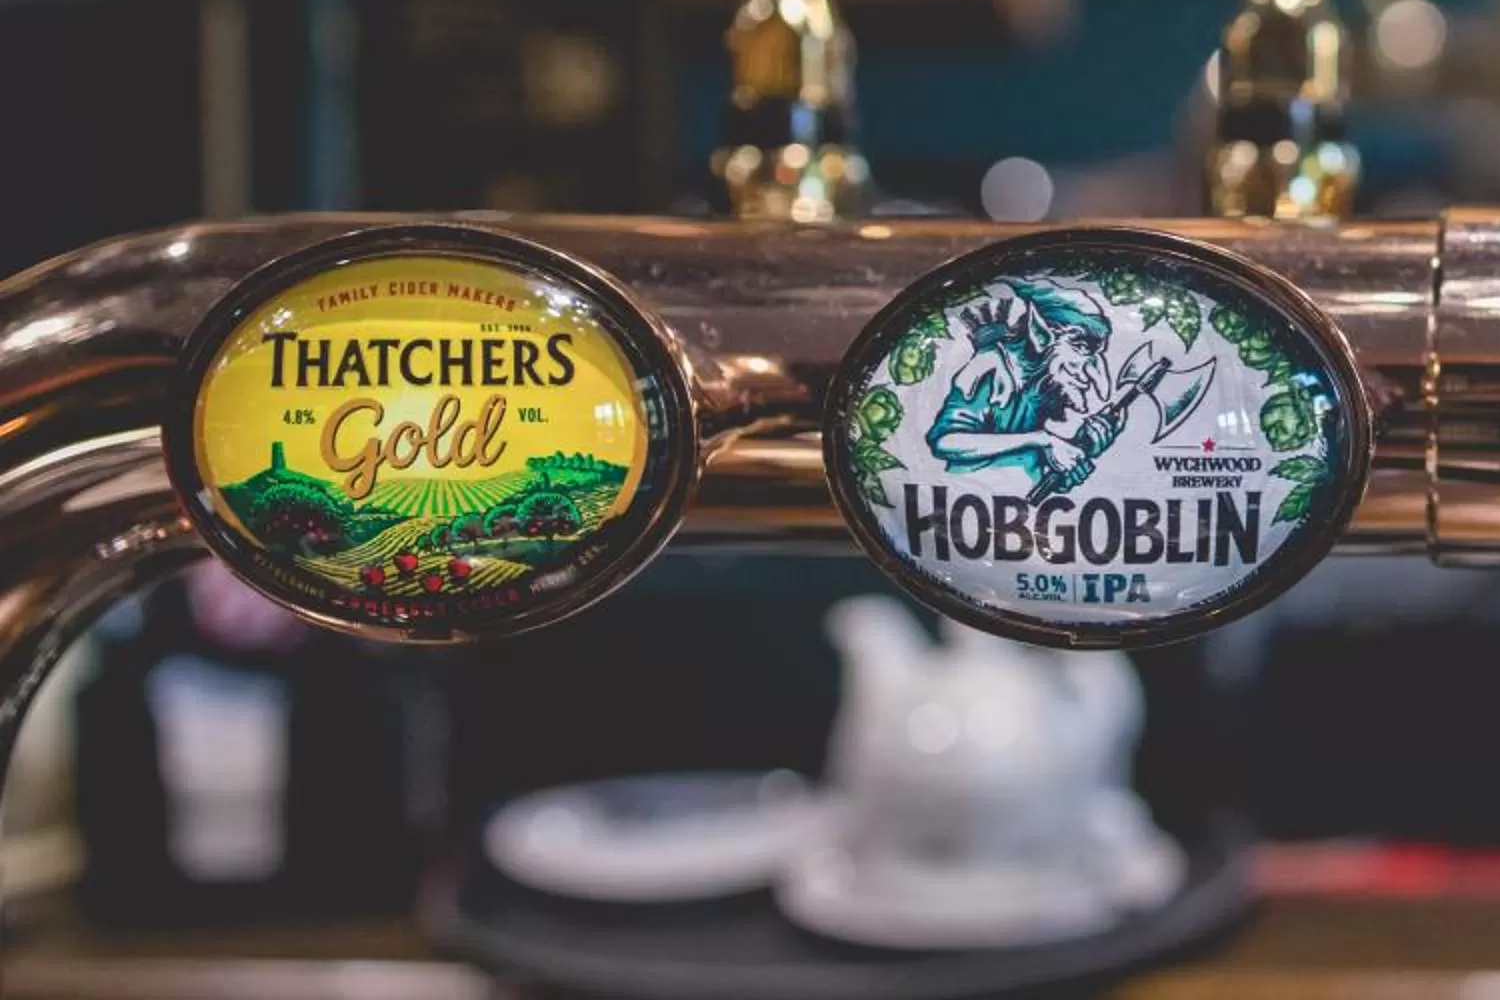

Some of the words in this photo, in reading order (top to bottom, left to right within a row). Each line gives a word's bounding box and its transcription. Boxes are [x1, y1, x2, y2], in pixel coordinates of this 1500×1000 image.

[317, 284, 378, 313] FAMILY
[388, 281, 438, 297] CIDER
[448, 283, 516, 313] MAKERS
[262, 332, 575, 388] THATCHERS
[283, 408, 317, 426] 4.8%
[518, 407, 549, 424] VOL.
[320, 394, 509, 500] Gold
[1153, 456, 1261, 473] WYCHWOOD
[1171, 475, 1243, 488] BREWERY
[903, 484, 1264, 567] HOBGOBLIN
[1016, 573, 1067, 594] 5.0%
[1081, 573, 1151, 604] IPA
